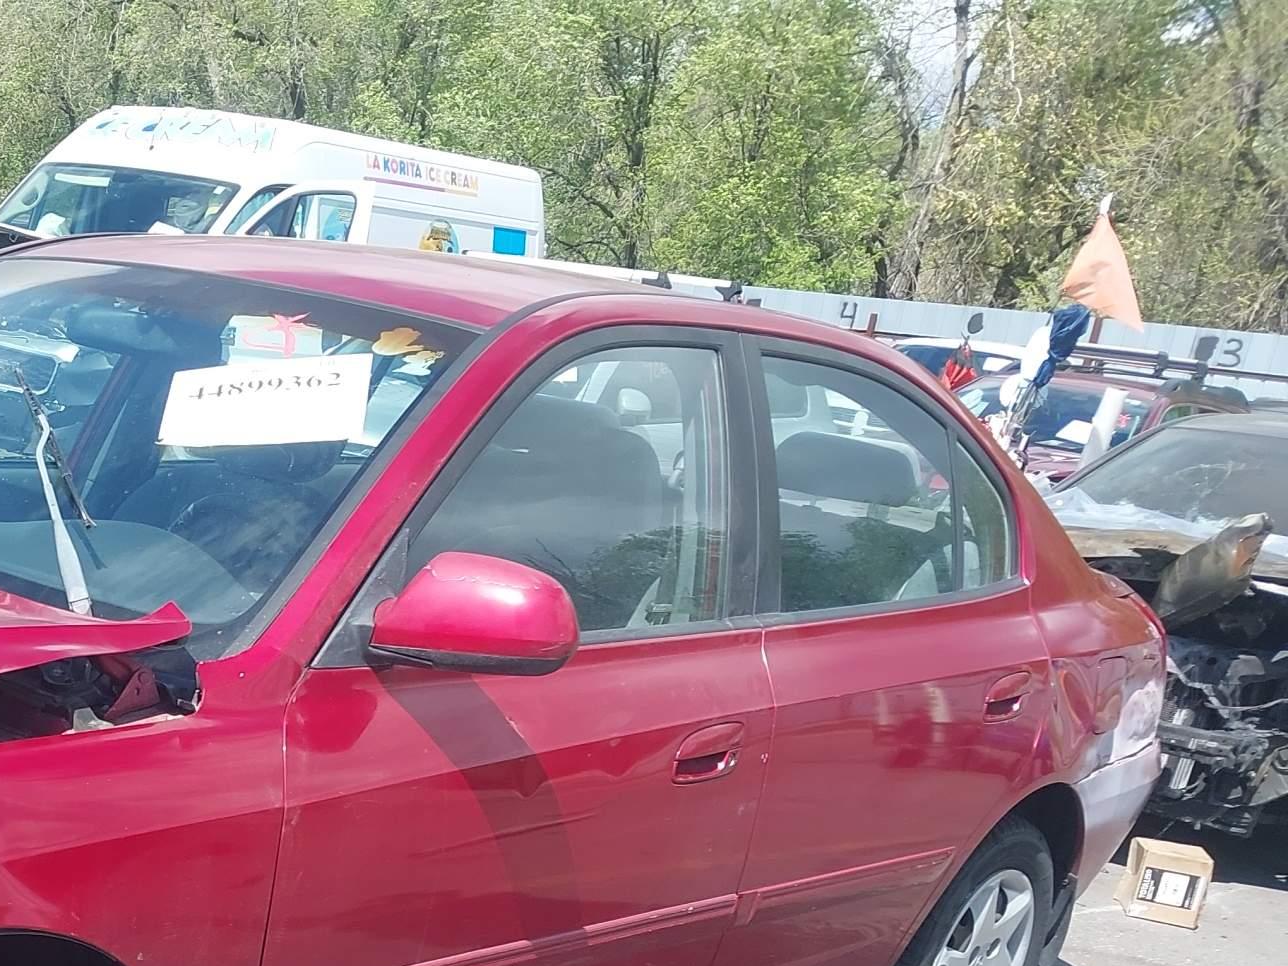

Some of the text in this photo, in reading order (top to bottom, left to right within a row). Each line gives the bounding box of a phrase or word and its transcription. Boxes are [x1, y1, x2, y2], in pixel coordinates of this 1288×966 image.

[365, 153, 479, 191] LA KORITA ICE CREAM
[840, 302, 858, 329] 4
[1216, 338, 1243, 368] 3
[188, 372, 342, 401] 44899362
